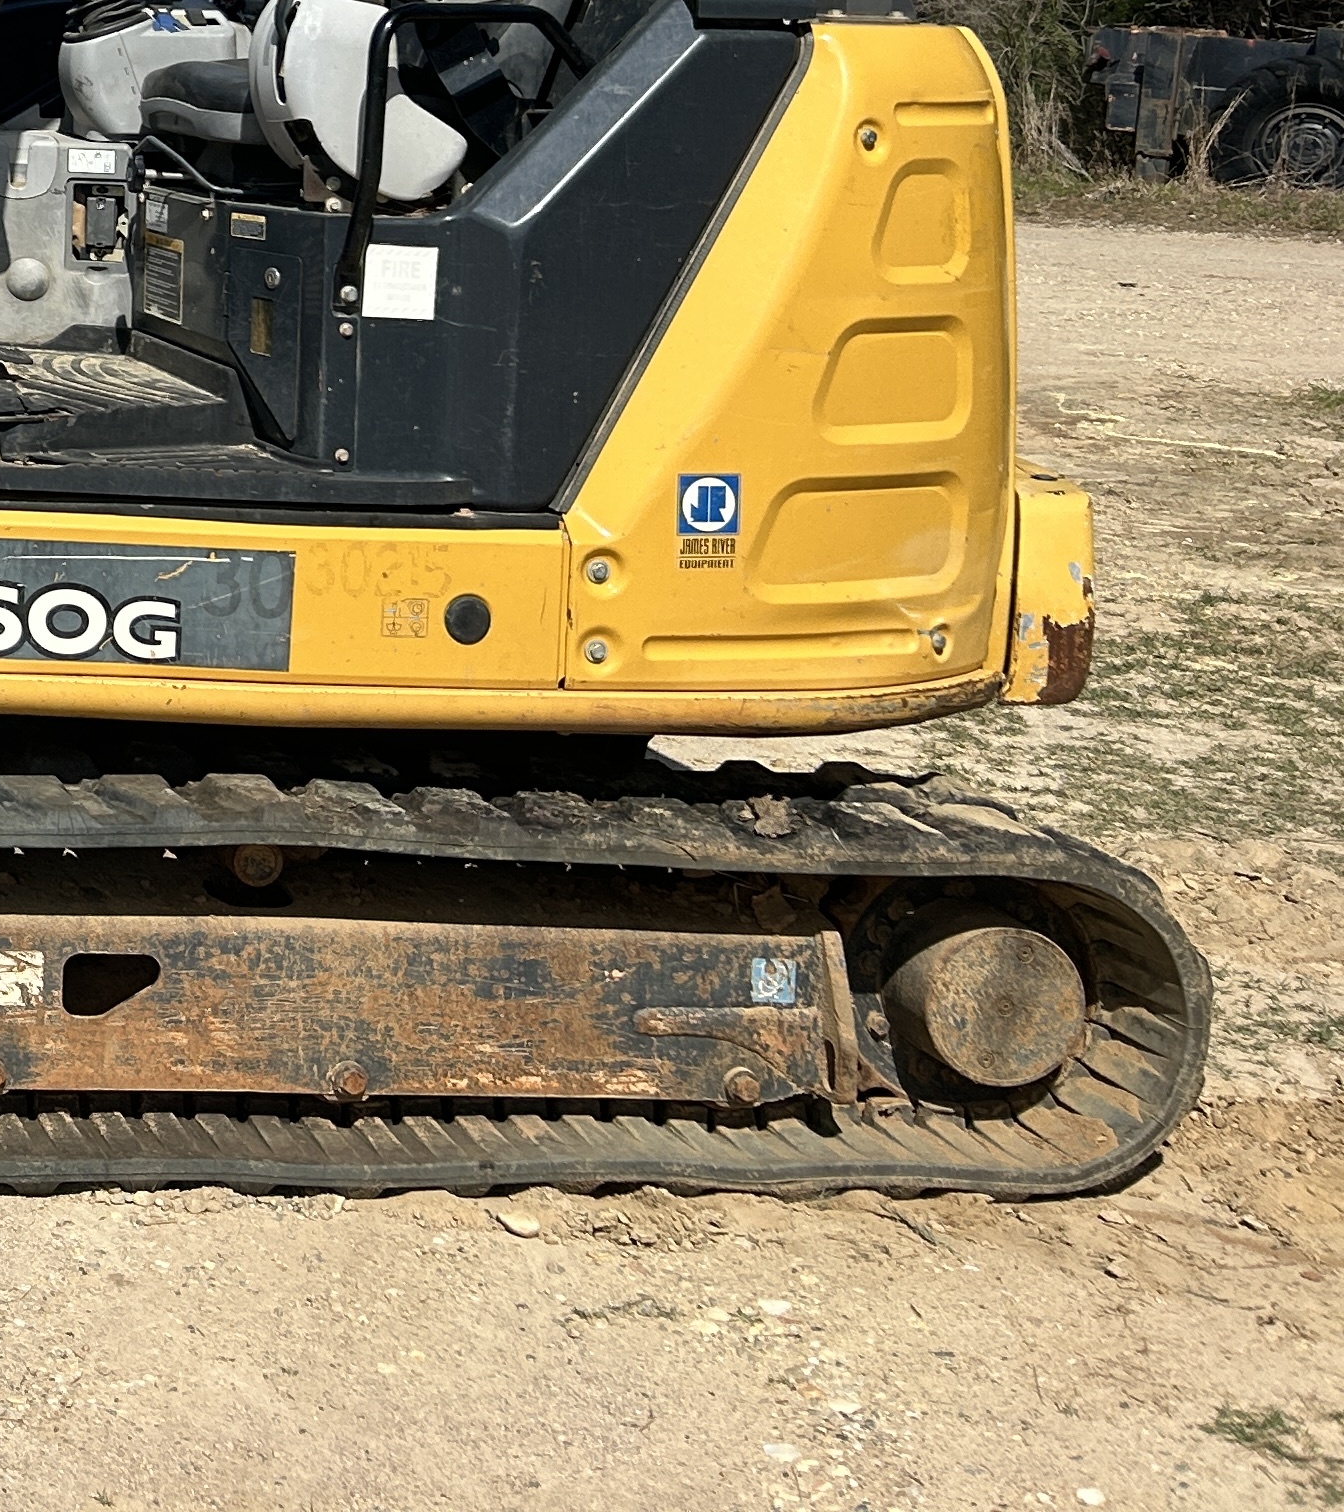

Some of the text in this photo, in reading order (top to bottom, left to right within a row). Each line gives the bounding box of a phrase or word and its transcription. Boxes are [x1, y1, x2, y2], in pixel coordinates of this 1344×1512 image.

[381, 259, 422, 279] FIRE
[679, 537, 737, 555] JAMES RIVER
[679, 559, 734, 569] EQUIPMENT
